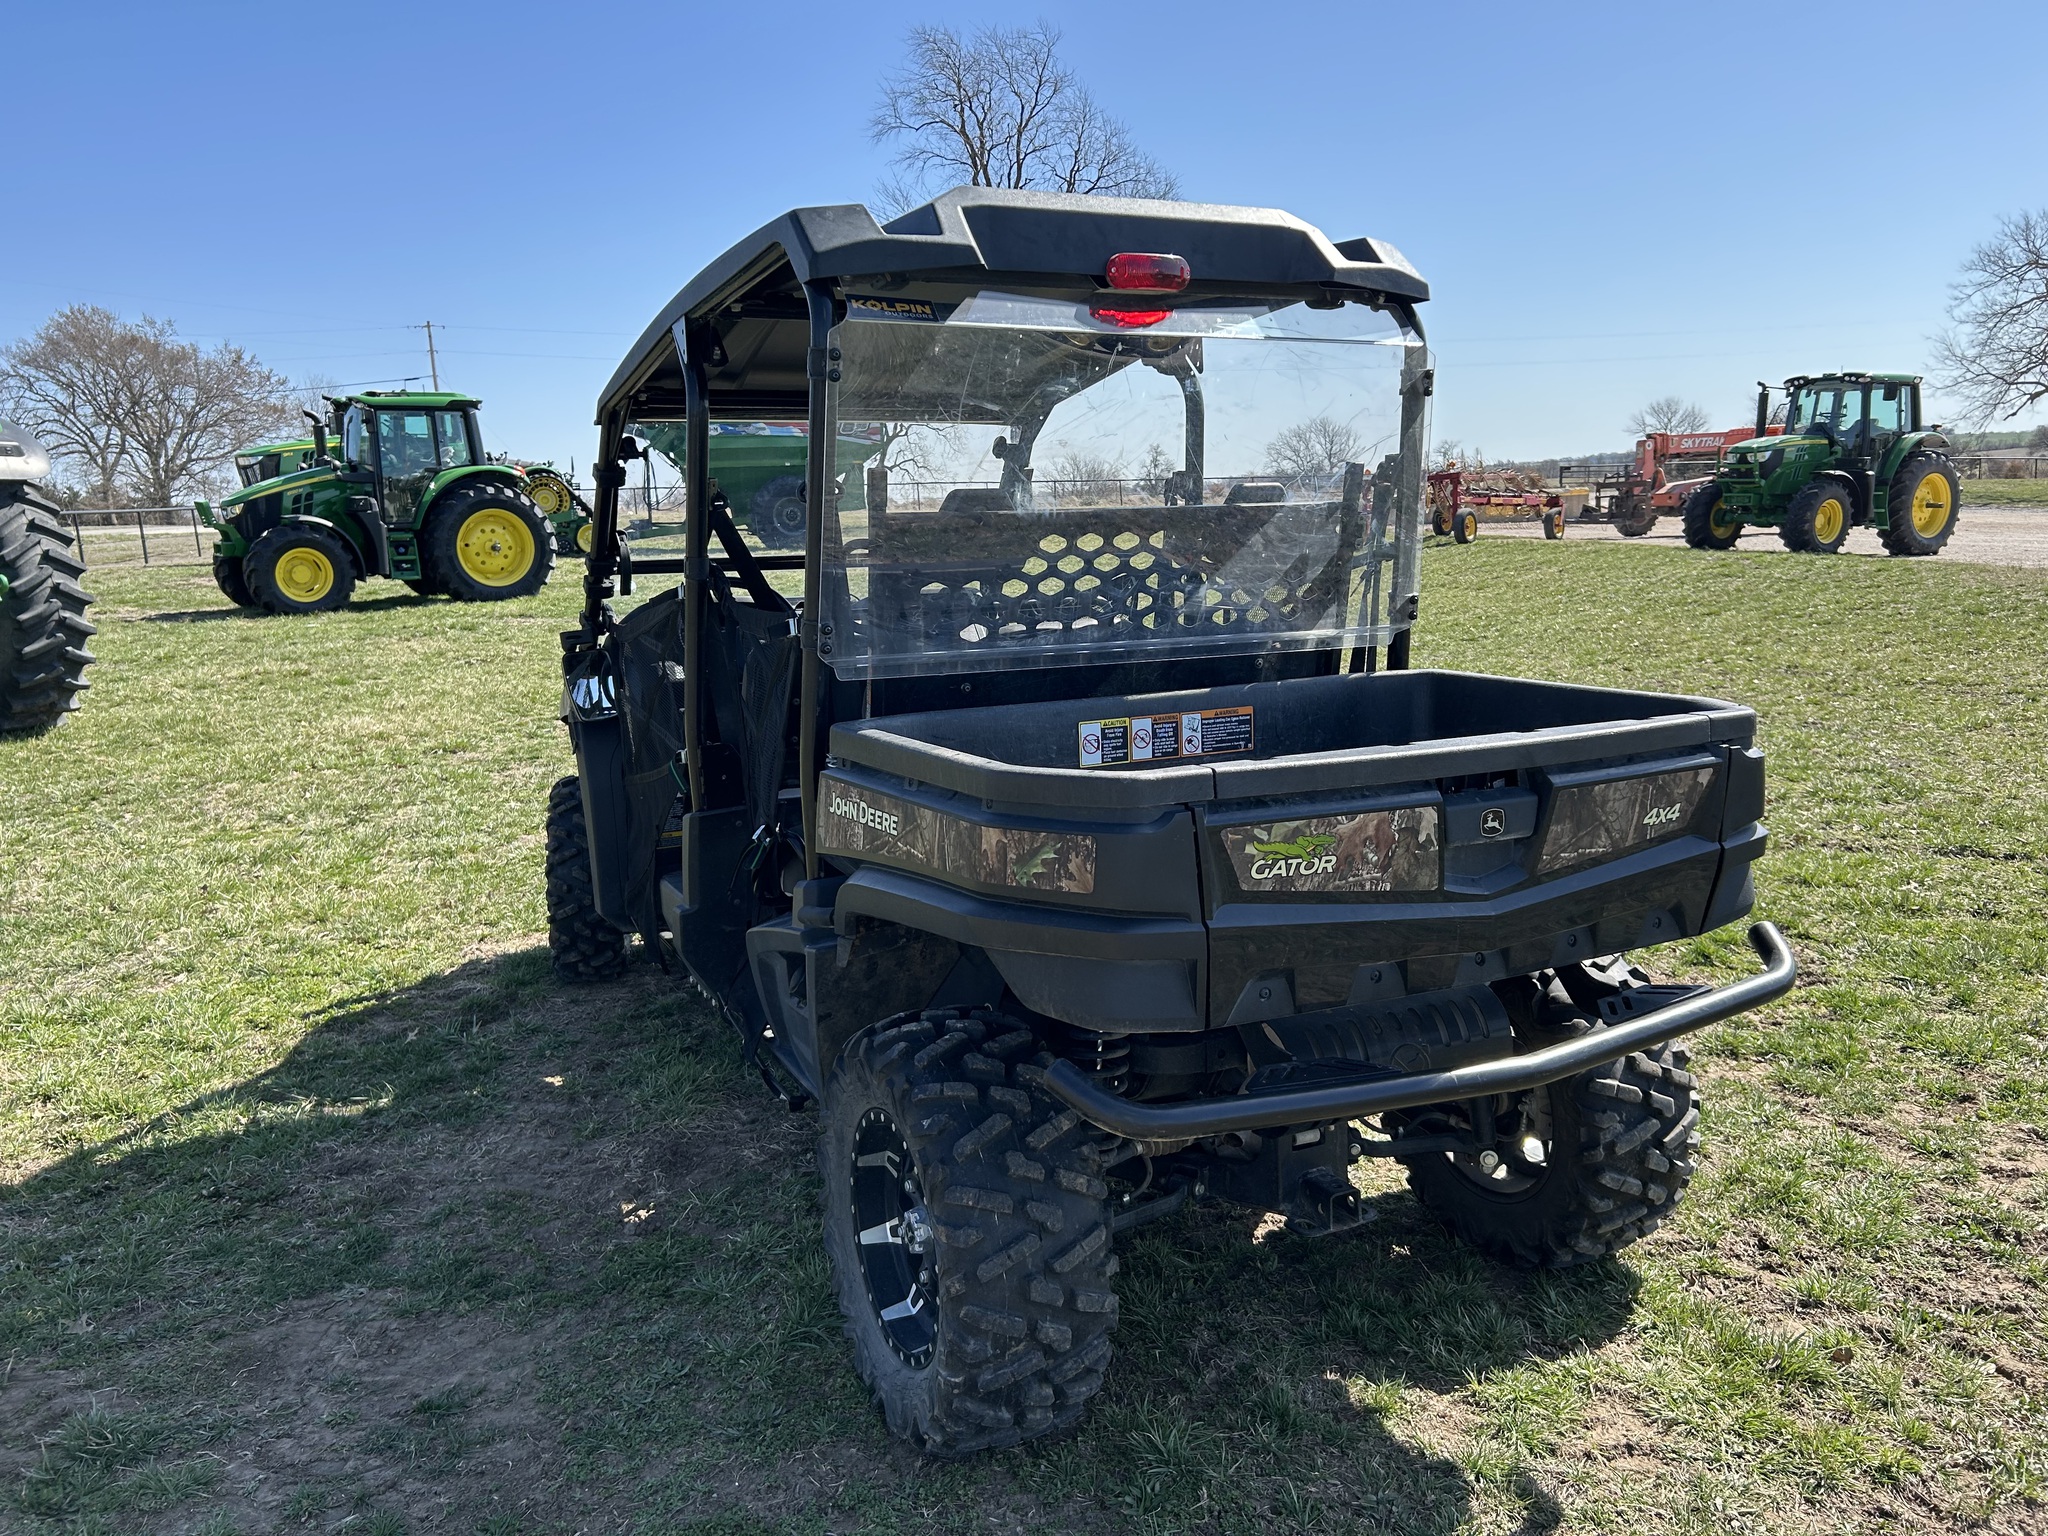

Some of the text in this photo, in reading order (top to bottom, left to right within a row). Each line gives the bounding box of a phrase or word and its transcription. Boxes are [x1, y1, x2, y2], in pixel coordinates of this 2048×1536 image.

[851, 299, 932, 314] KOLPIN
[884, 311, 934, 319] OUTDOORS
[829, 791, 898, 836] JOHN DEERE
[1250, 855, 1338, 880] GATOR
